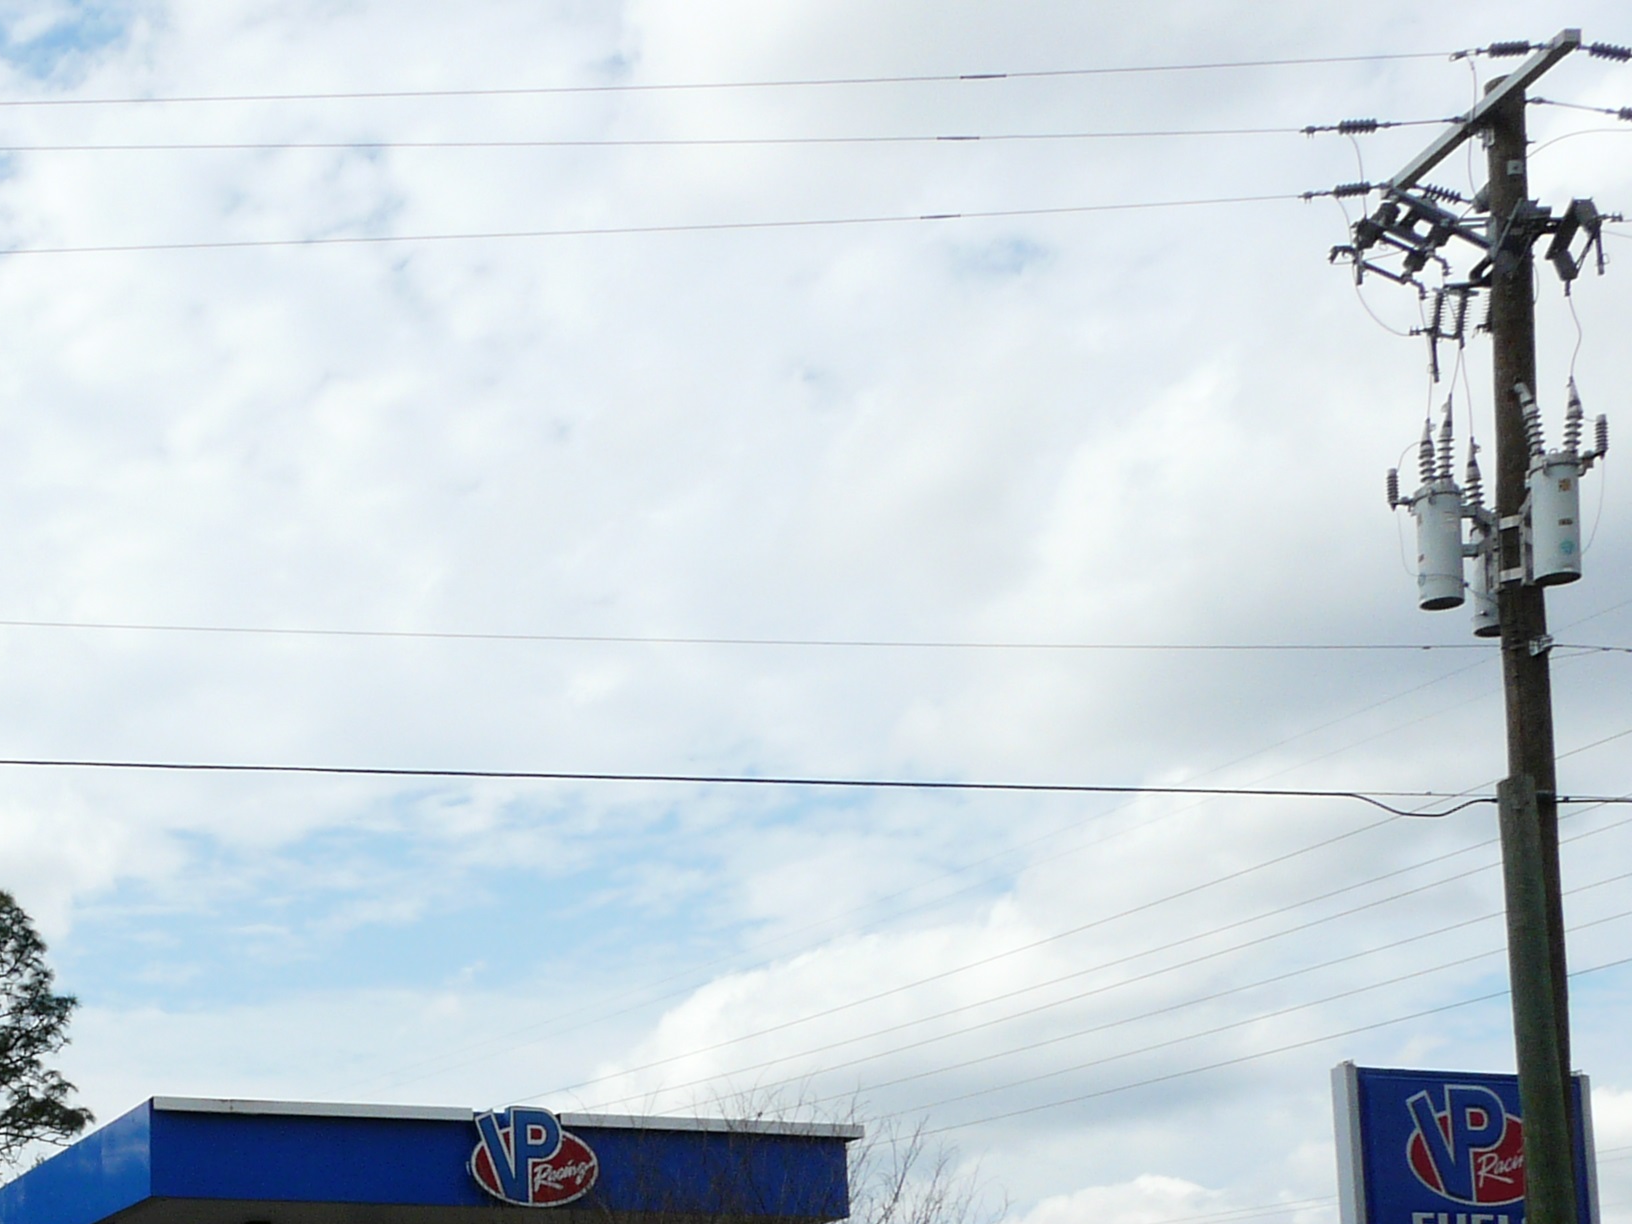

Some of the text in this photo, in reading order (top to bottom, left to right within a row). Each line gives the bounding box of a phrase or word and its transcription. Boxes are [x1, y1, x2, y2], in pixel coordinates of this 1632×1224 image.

[475, 1106, 563, 1204] VP
[533, 1160, 595, 1192] Racing
[1406, 1084, 1506, 1205] VP
